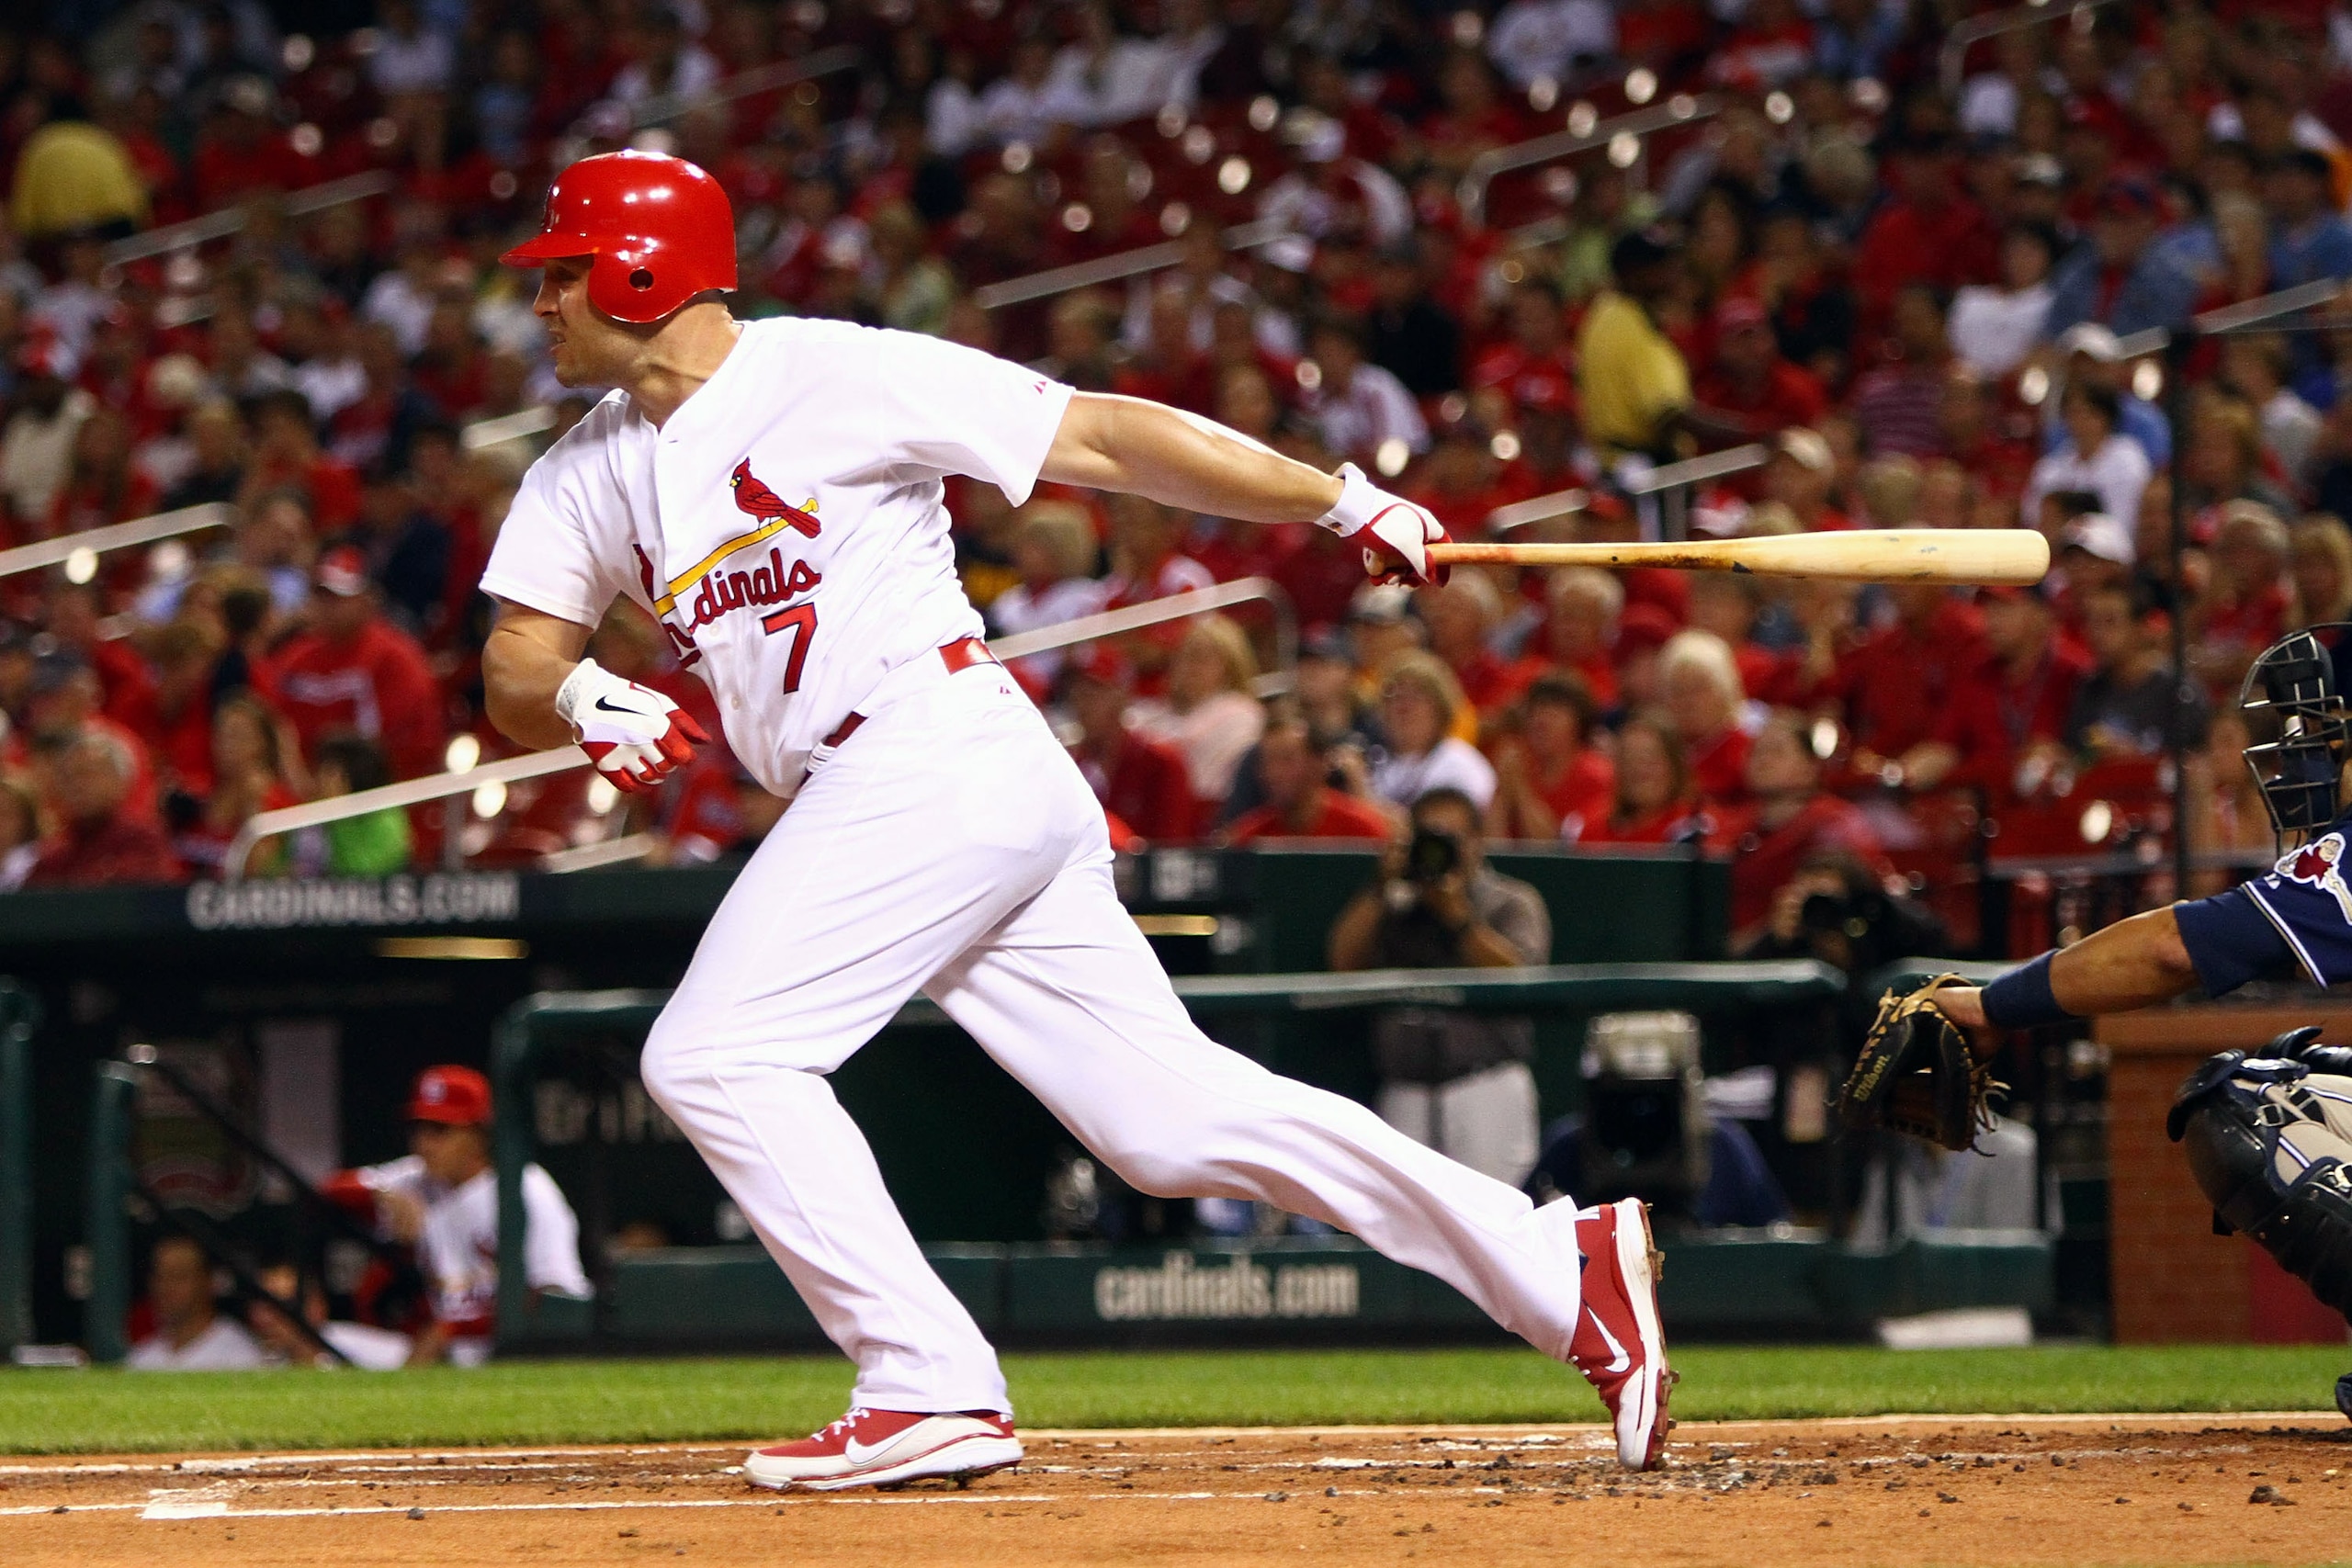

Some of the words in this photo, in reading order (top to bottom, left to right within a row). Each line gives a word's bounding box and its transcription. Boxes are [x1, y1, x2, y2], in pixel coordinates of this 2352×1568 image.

[761, 602, 818, 695] 7
[187, 874, 520, 930] CARDINALS.COM
[1094, 1250, 1360, 1320] cardinals.com
